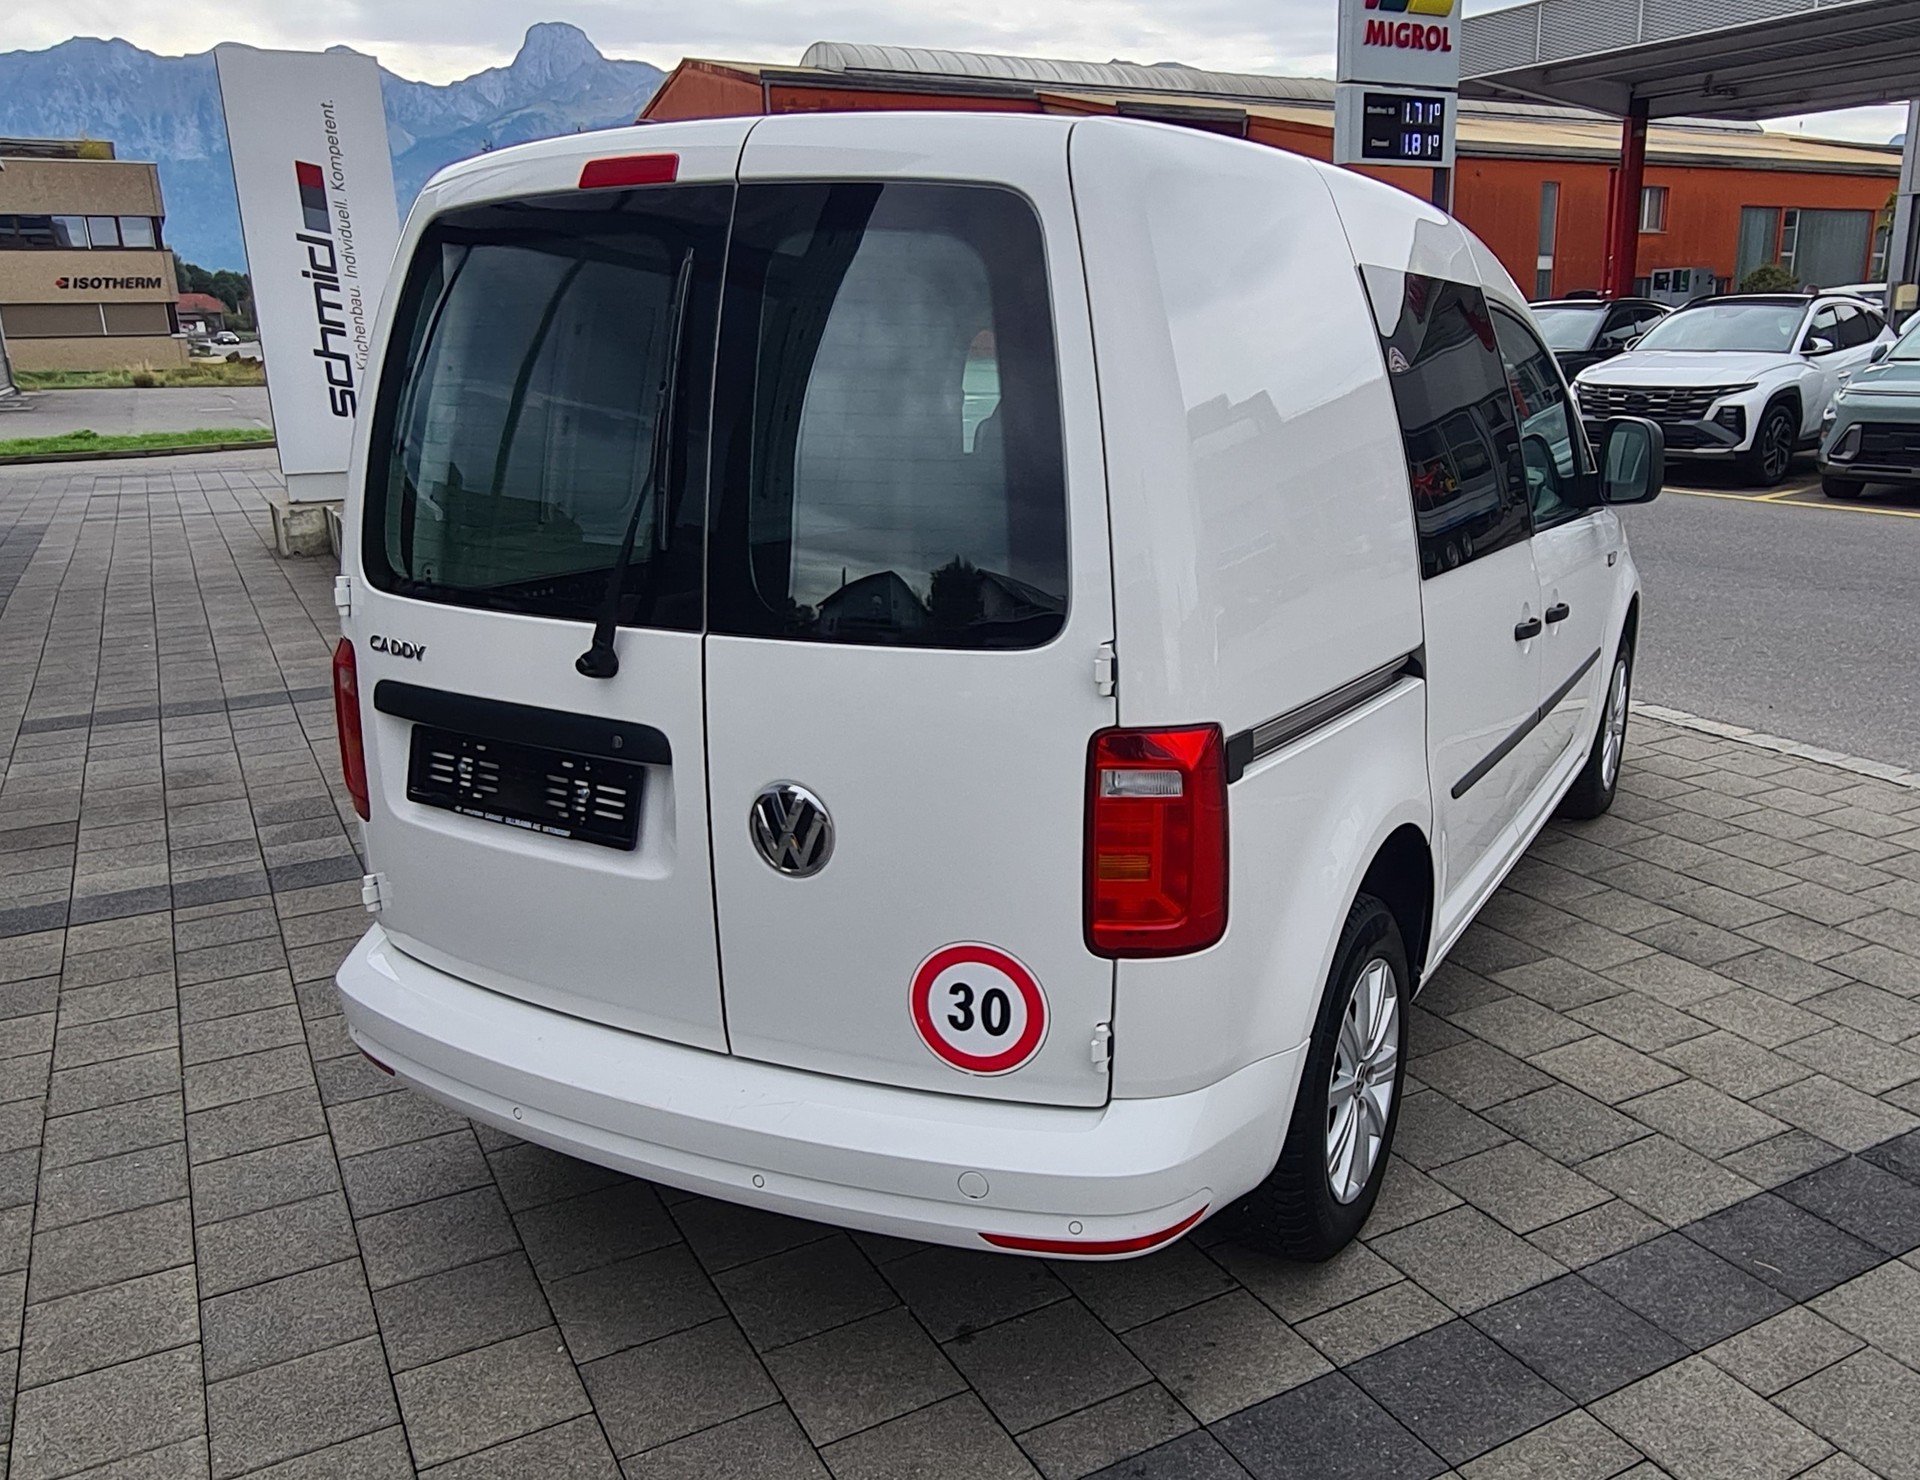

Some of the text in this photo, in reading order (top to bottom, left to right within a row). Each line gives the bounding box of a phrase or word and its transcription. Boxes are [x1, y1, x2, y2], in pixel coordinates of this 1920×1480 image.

[1364, 19, 1452, 52] MIGROL
[320, 99, 346, 192] Kompetent.
[332, 198, 359, 279] Individuell.
[72, 276, 162, 290] ISOTHERM
[296, 232, 357, 419] schmid
[370, 634, 427, 662] CADDY
[947, 982, 1012, 1036] 30
